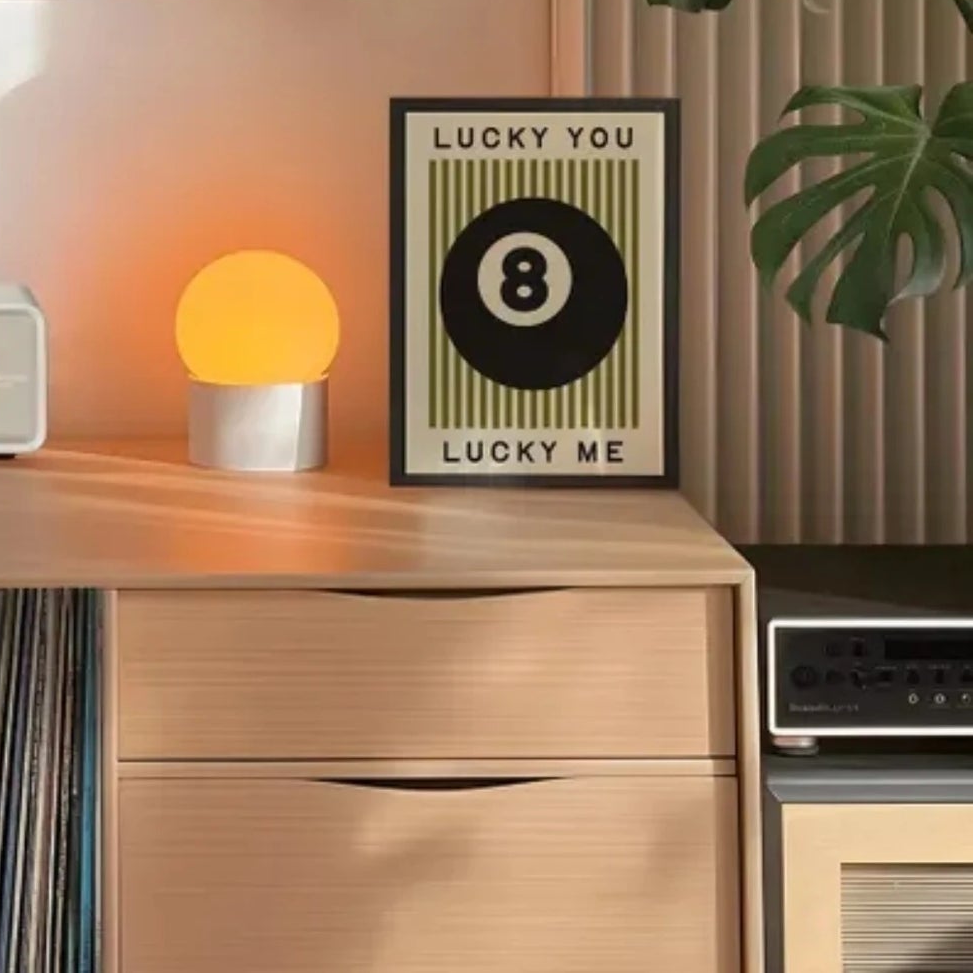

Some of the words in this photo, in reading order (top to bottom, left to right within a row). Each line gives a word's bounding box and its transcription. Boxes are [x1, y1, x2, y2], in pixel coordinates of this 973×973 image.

[434, 126, 548, 149] LUCKY
[567, 126, 634, 149] YOU
[500, 246, 549, 312] 8
[443, 440, 557, 463] LUCKY
[578, 440, 624, 463] ME
